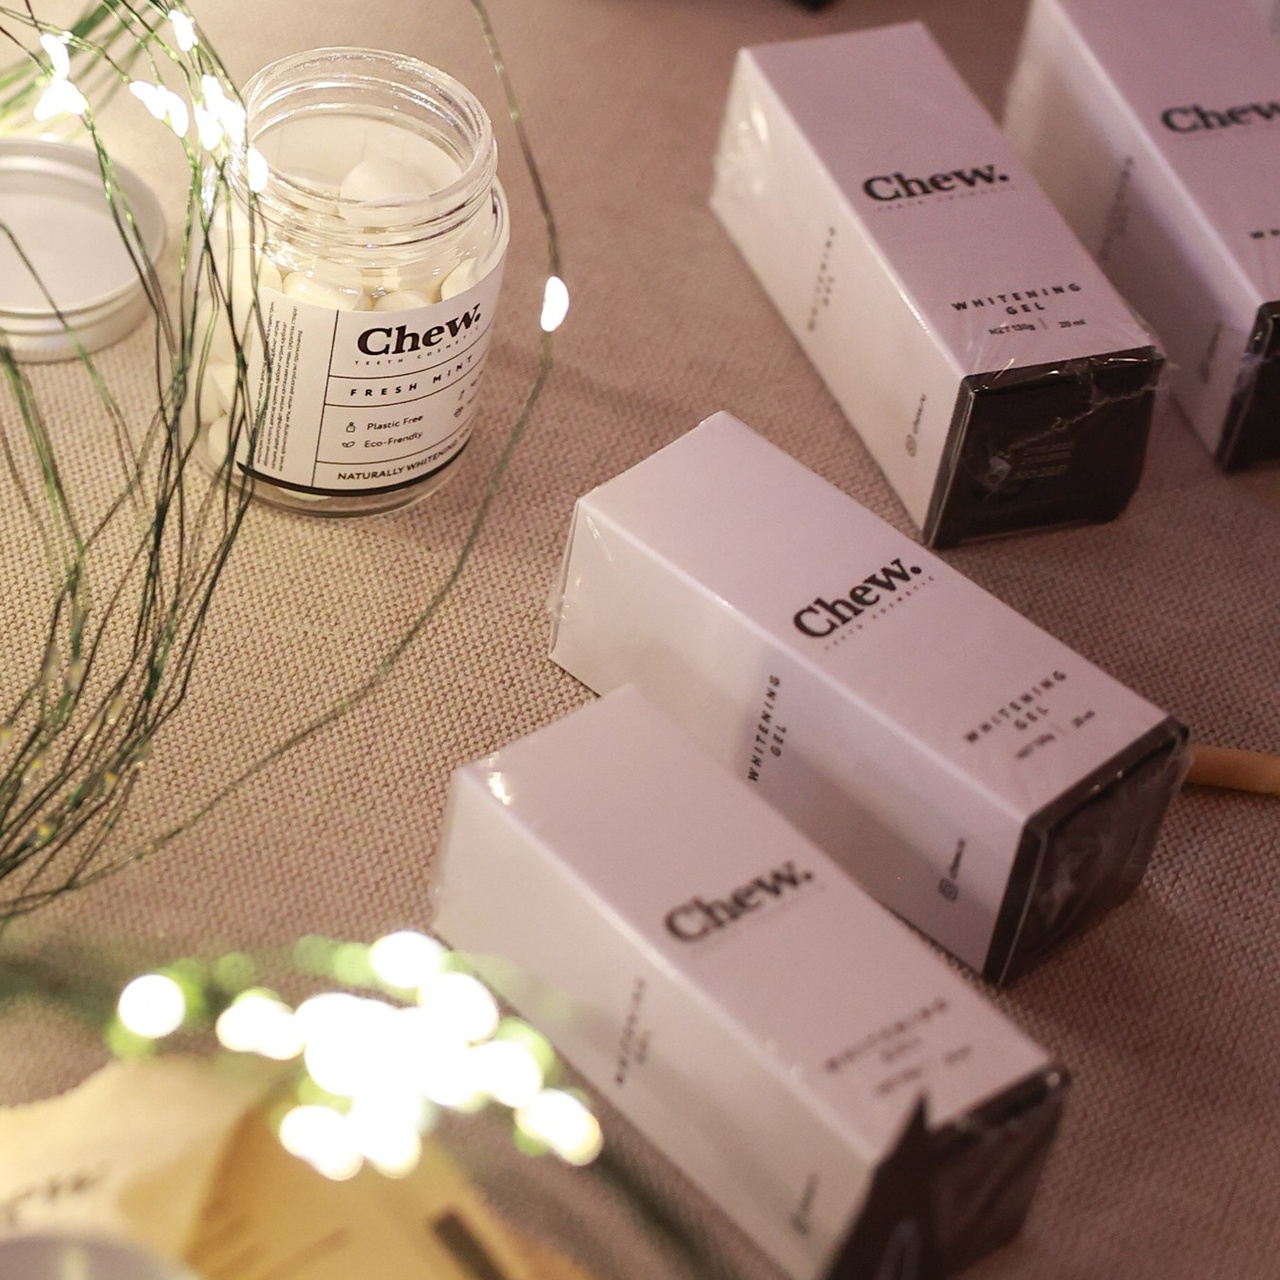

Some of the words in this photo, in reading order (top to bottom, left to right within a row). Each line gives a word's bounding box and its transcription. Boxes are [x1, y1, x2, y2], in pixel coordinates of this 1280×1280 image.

[863, 164, 1010, 202] Chew.
[951, 282, 1082, 312] WHITENING
[1005, 302, 1046, 315] GEL
[357, 303, 482, 357] Chew.
[350, 382, 418, 398] FRESH
[431, 354, 474, 385] MINT
[366, 418, 401, 431] Plastic
[402, 414, 424, 427] Free
[336, 465, 405, 481] NATURALLY
[406, 440, 458, 472] WHITENING
[793, 557, 923, 639] Chew.
[747, 674, 781, 782] WHITENING
[1013, 704, 1050, 732] GEL
[770, 724, 787, 758] GEL
[664, 859, 814, 943] Chew.
